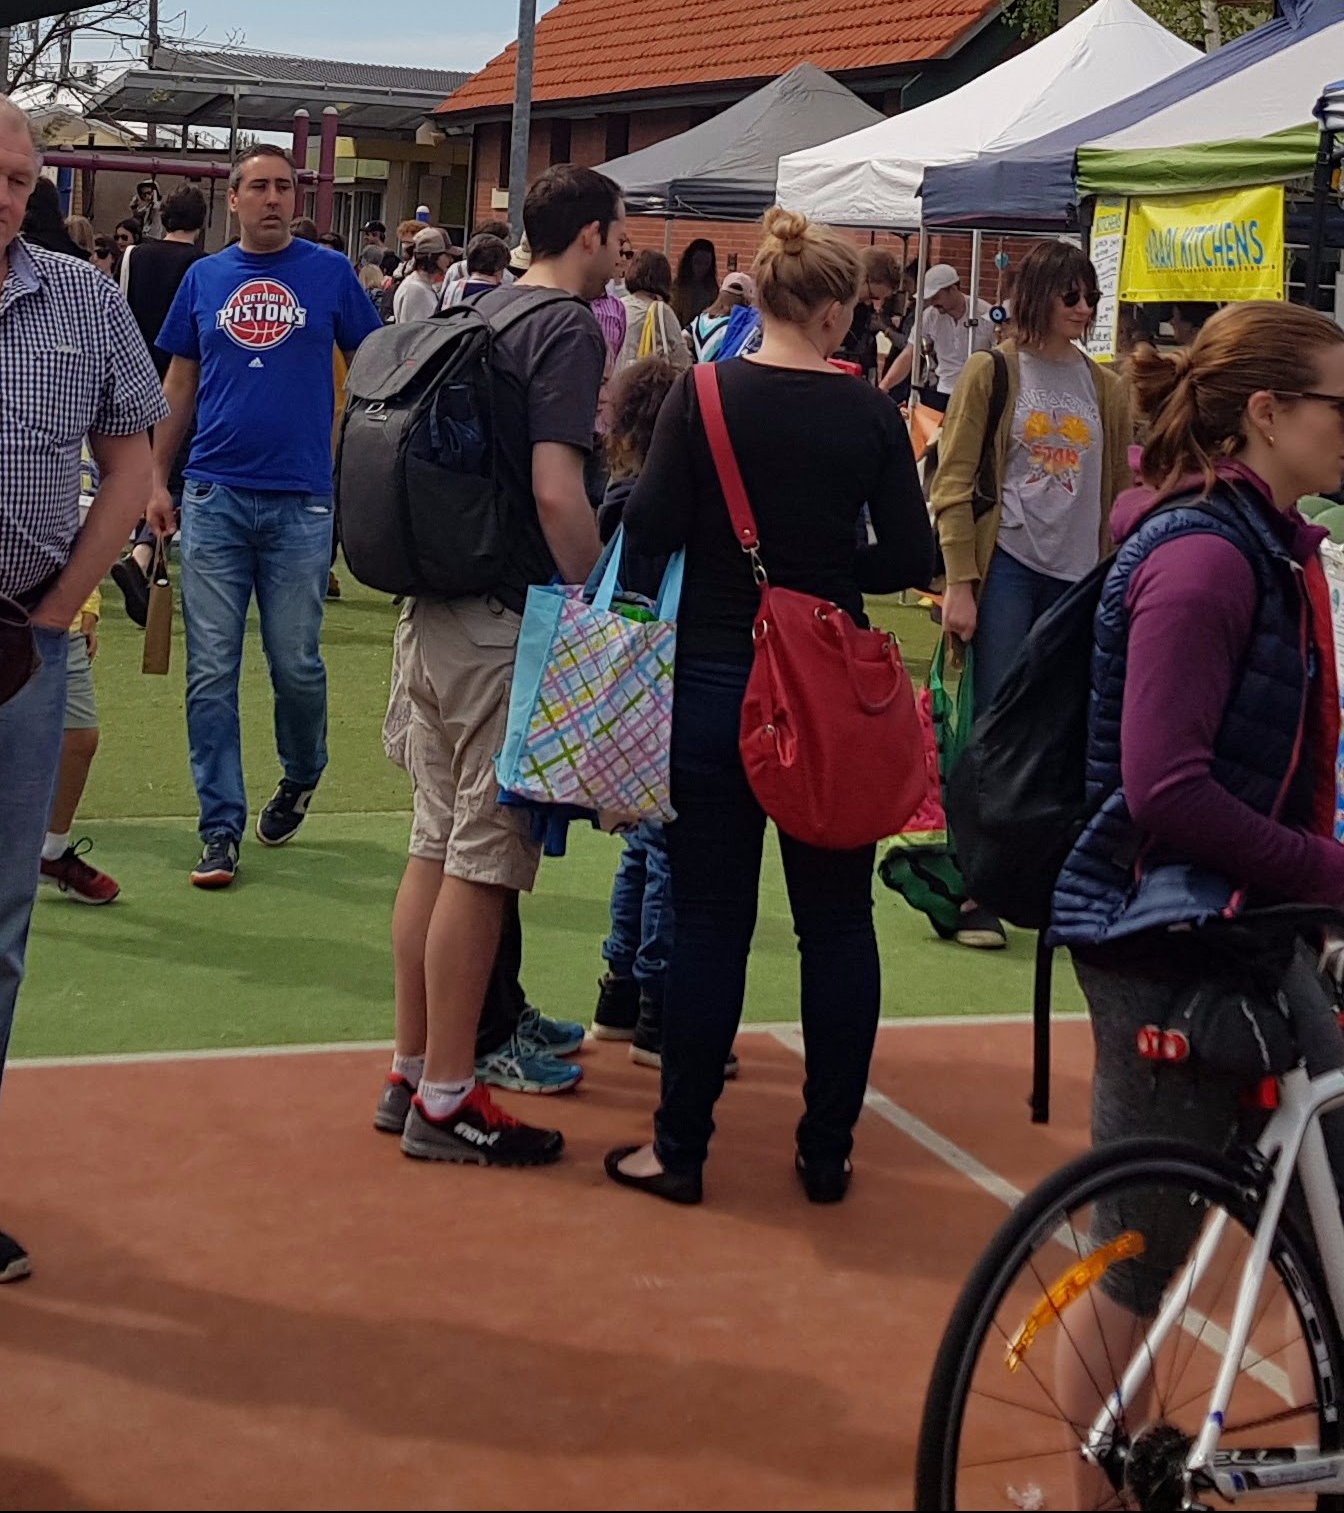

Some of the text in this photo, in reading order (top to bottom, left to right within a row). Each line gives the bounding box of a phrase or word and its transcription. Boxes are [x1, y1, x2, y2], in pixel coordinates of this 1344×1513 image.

[1181, 219, 1264, 268] KITCHENS
[243, 292, 285, 304] DETROIT
[216, 303, 307, 328] PISTONS
